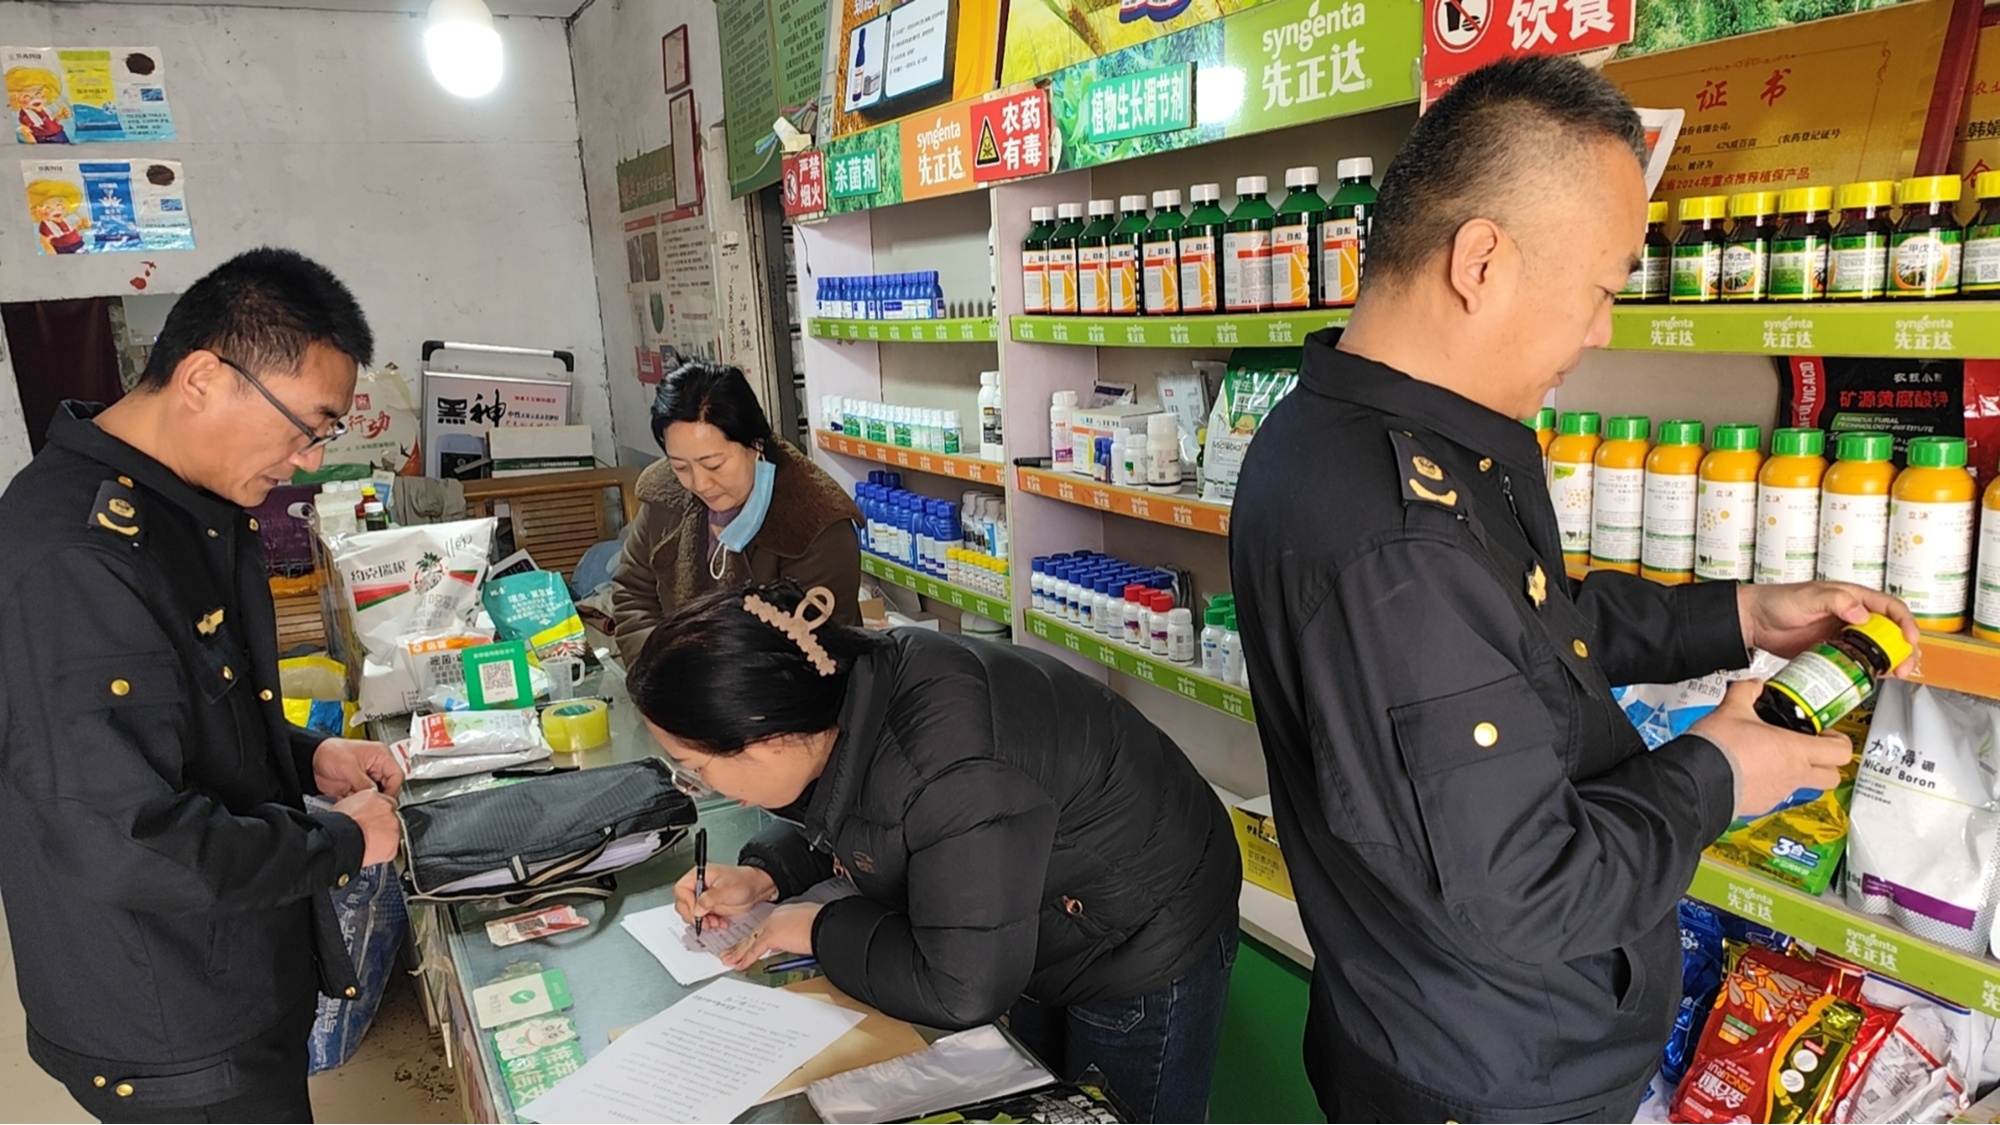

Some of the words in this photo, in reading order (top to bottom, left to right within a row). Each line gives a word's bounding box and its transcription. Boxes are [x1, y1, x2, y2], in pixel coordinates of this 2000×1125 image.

[1262, 3, 1365, 60] syngenta
[1507, 0, 1615, 50] 饮食
[1262, 38, 1366, 112] 先正达
[1091, 71, 1184, 136] 植物生长调节剂
[1696, 68, 1791, 112] 证书
[1001, 96, 1041, 131] 农药
[916, 121, 961, 149] syngenta
[1002, 133, 1041, 170] 有毒
[799, 155, 820, 181] 严禁
[834, 153, 878, 192] 杀菌剂
[918, 146, 964, 186] 先正达
[800, 184, 822, 208] 烟火
[1651, 318, 1694, 333] syngenta
[1764, 317, 1813, 333] syngenta
[1895, 316, 1953, 333] syngenta
[1651, 331, 1694, 347] 先正达
[1763, 331, 1813, 348] 先正达
[1895, 331, 1954, 350] 先正达
[437, 388, 507, 428] 黑神
[1840, 389, 1948, 408] 矿源黄腐酸钾
[1687, 680, 1722, 698] 颗粒剂
[1862, 758, 1892, 776] NiCad
[1898, 770, 1936, 789] Boron
[1729, 883, 1773, 906] syngenta
[1728, 896, 1774, 923] 先正达
[1846, 928, 1897, 954] syngenta
[1845, 940, 1899, 972] 先正达
